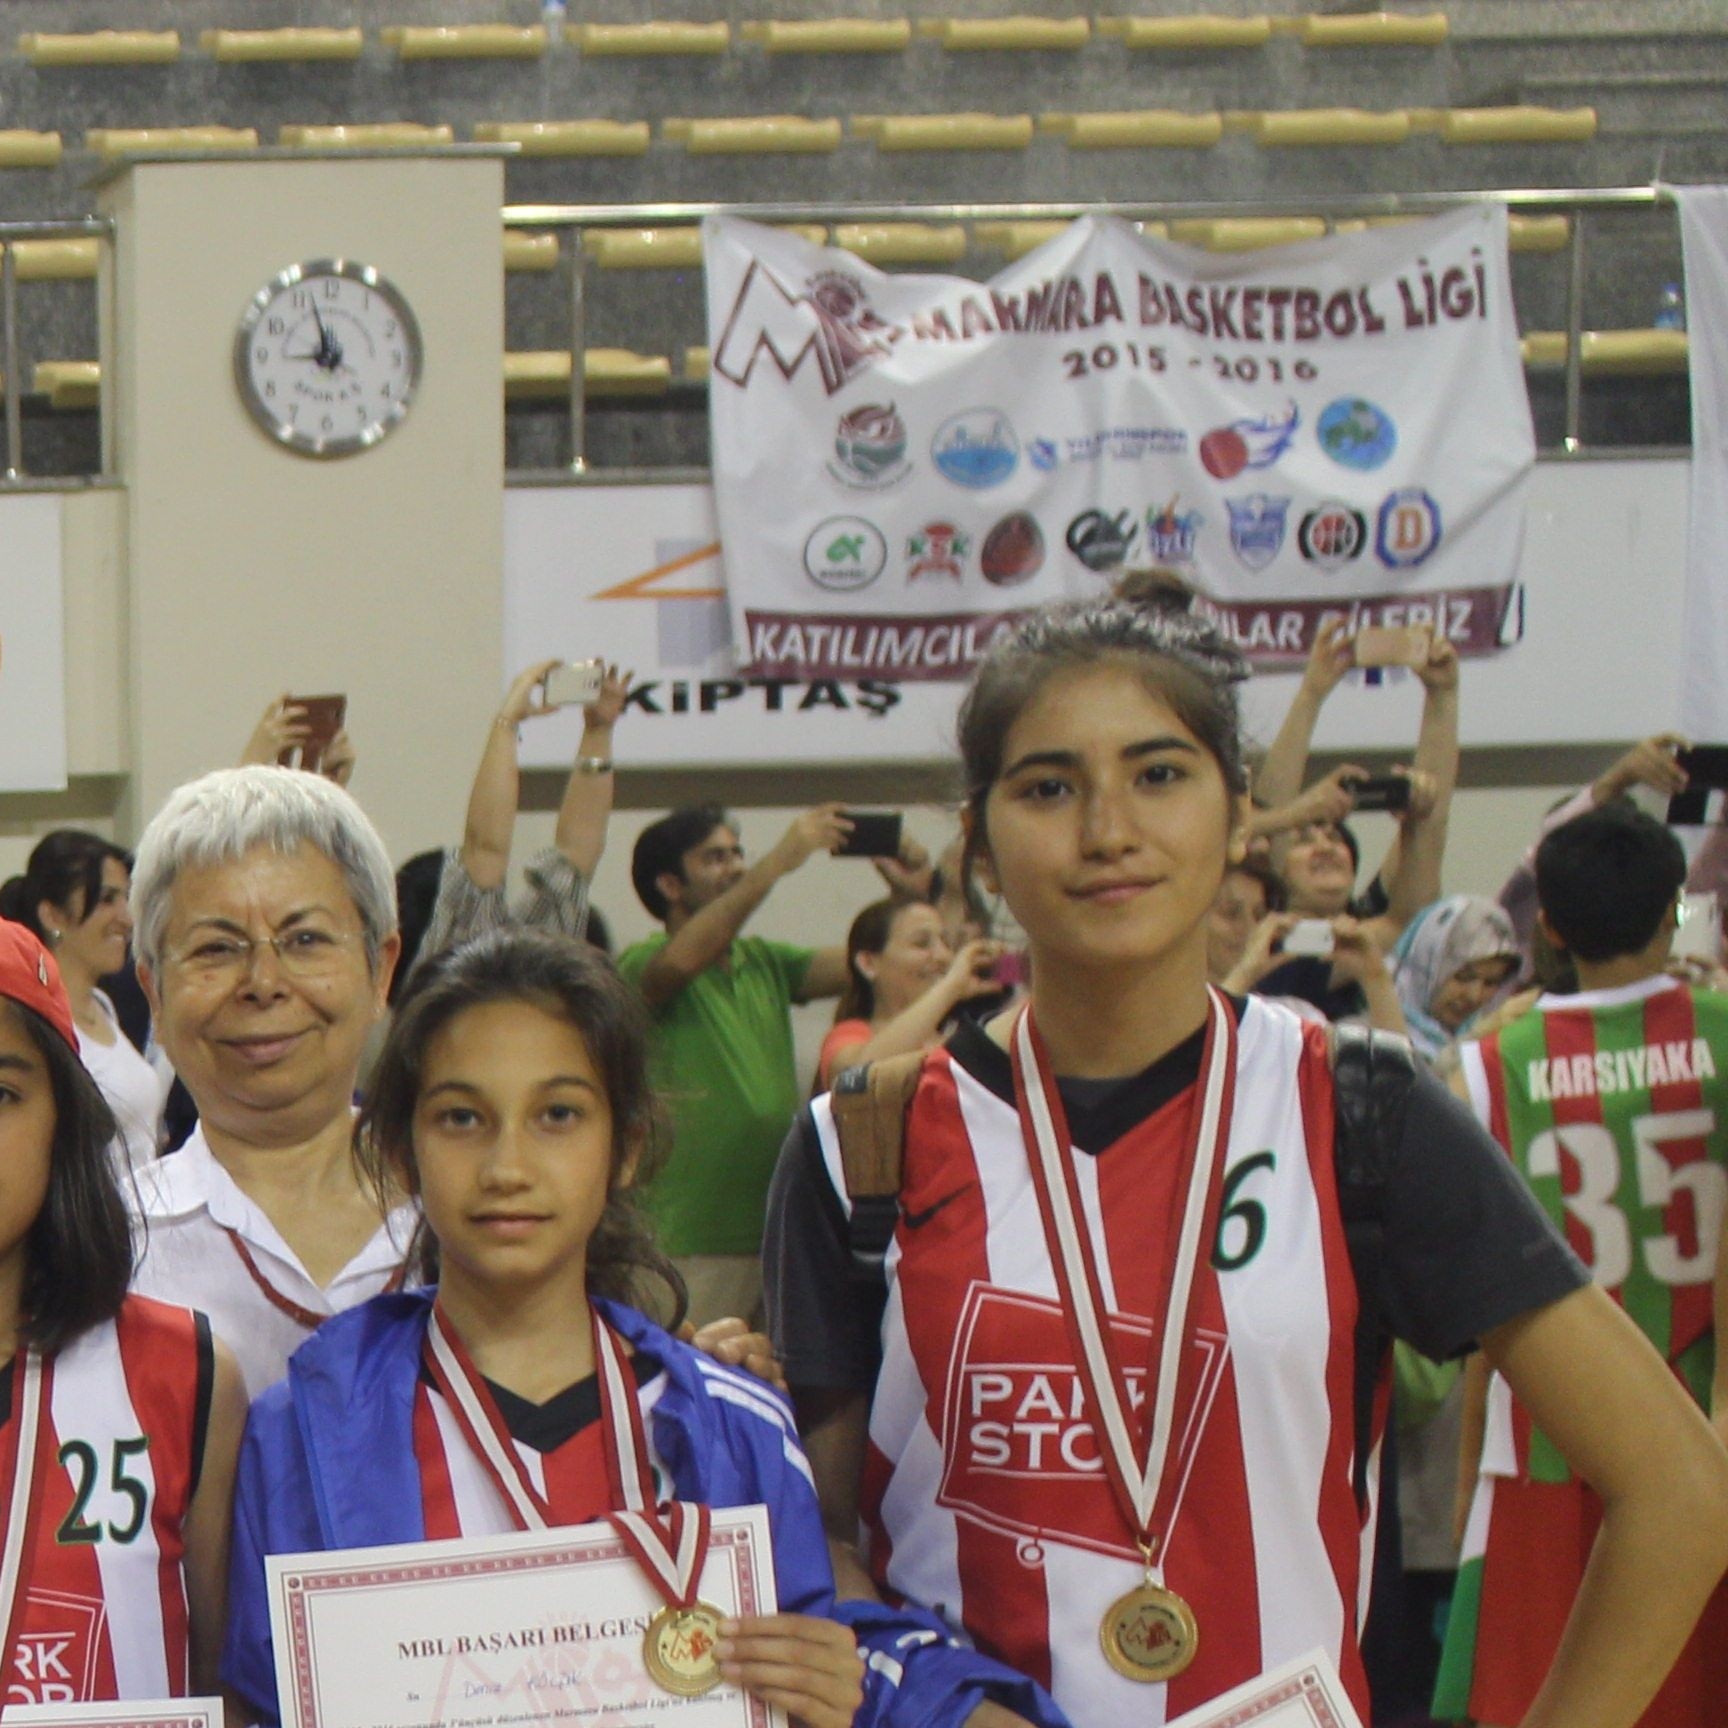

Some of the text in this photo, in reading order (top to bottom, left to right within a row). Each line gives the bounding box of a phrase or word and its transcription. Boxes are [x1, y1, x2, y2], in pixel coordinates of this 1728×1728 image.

[1397, 245, 1488, 330] LİGİ
[1062, 341, 1167, 381] 2015
[1212, 355, 1320, 383] 2016
[753, 620, 1014, 667] KATILIMCIL
[1209, 1149, 1277, 1273] 6
[1526, 1108, 1728, 1288] 35
[969, 1372, 1146, 1423] PA
[968, 1421, 1106, 1473] STO
[55, 1434, 150, 1546] 25
[397, 1637, 453, 1660] MBL
[456, 1629, 545, 1660] BAŞARI
